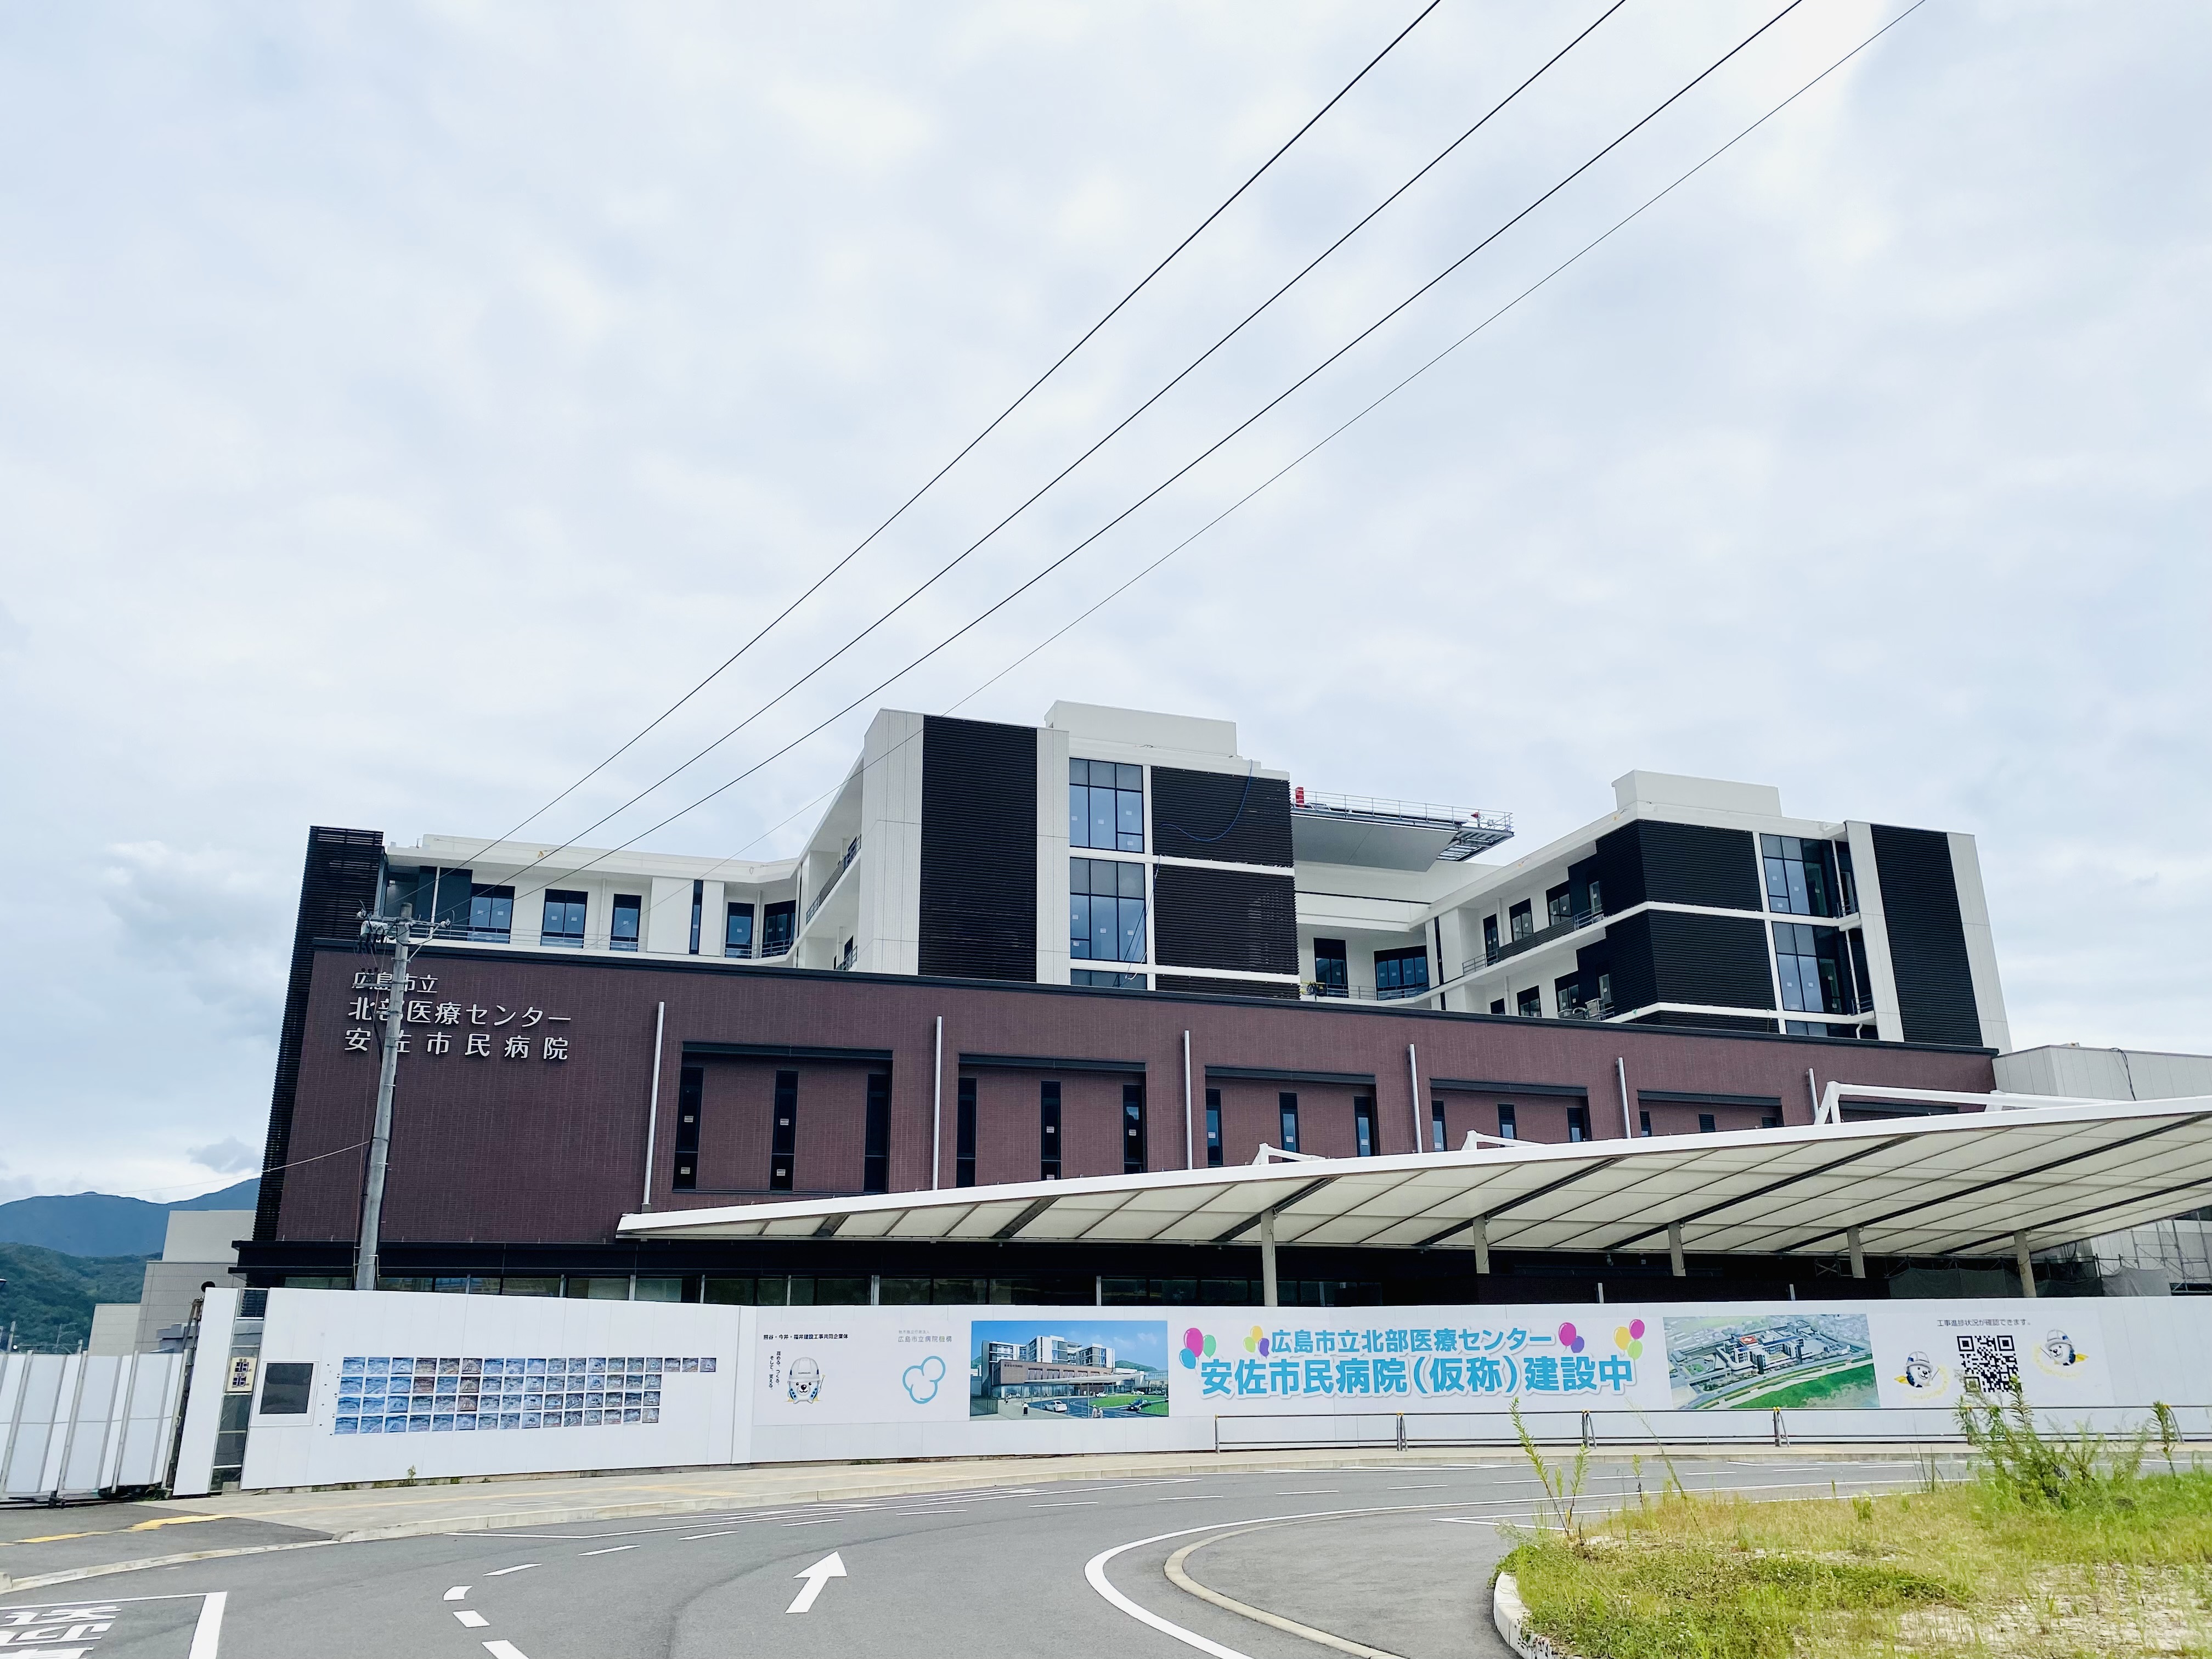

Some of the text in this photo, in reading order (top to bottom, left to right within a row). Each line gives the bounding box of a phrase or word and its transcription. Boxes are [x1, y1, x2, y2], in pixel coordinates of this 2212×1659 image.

[1271, 1329, 1552, 1356] 広島市立北部医療センター
[1201, 1355, 1634, 1395] 安佐市民病院(仮称)建設中
